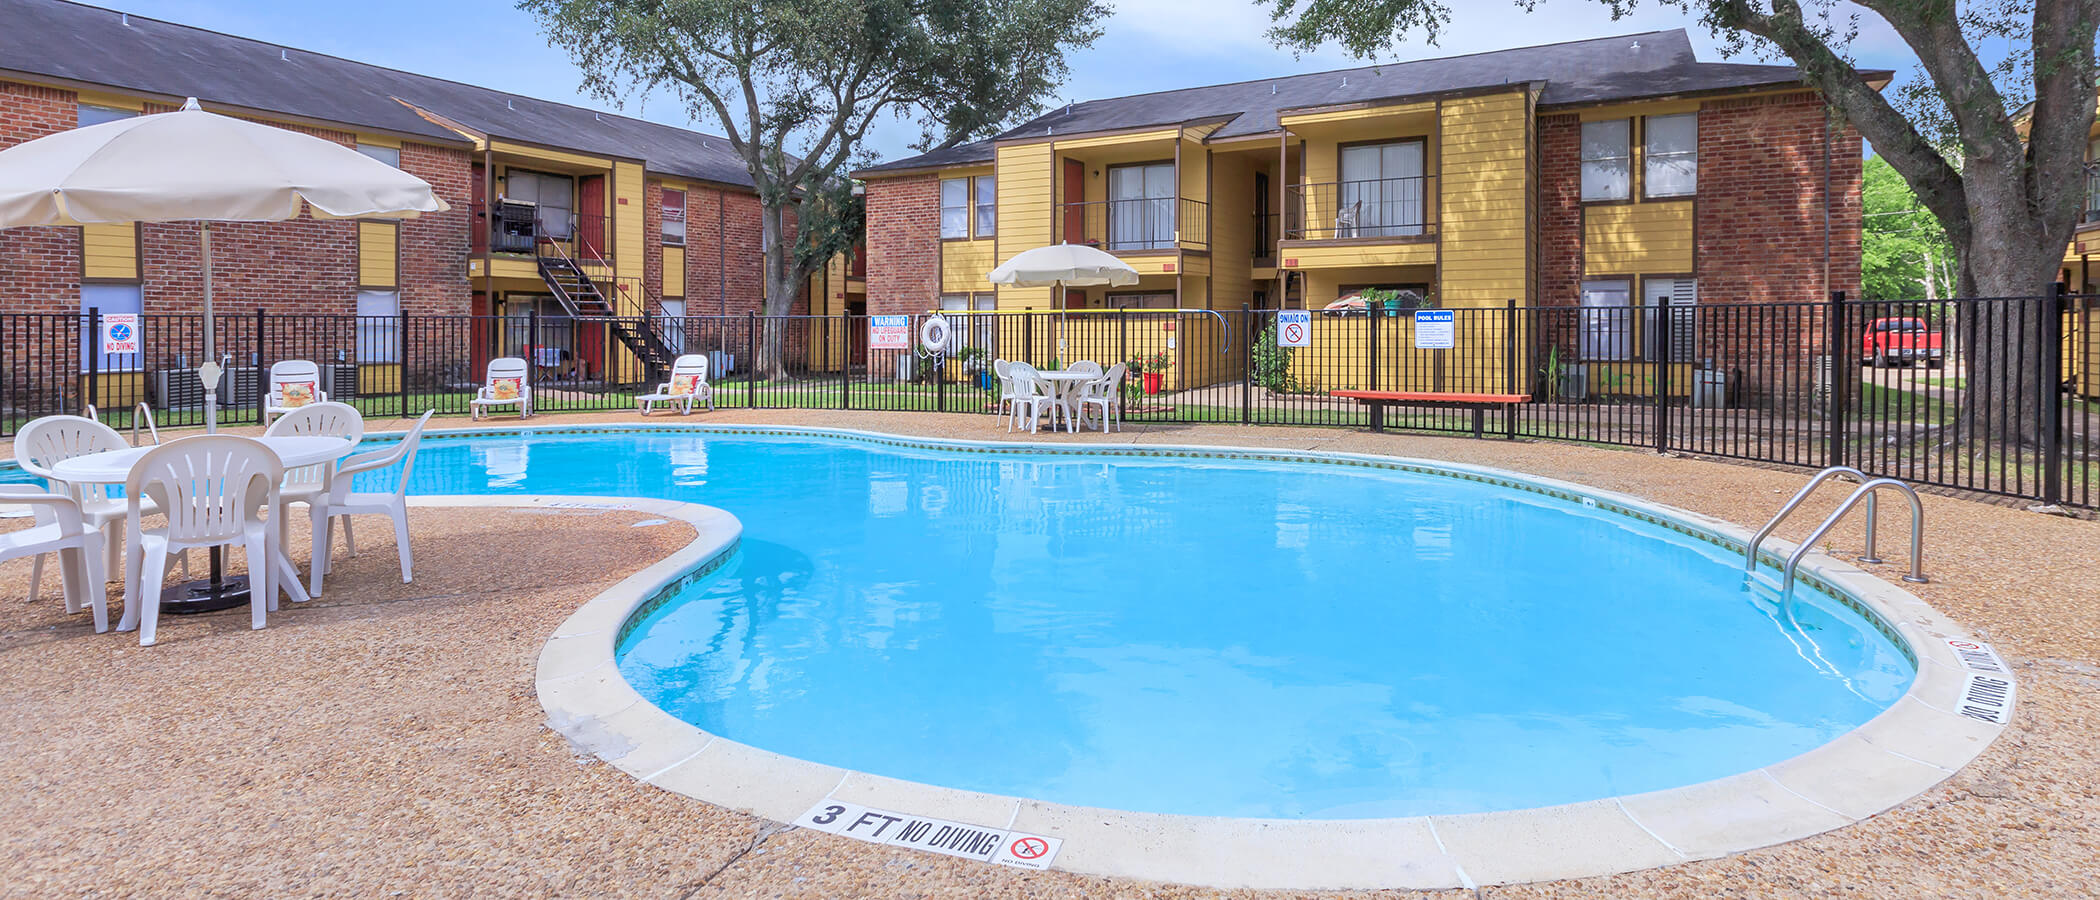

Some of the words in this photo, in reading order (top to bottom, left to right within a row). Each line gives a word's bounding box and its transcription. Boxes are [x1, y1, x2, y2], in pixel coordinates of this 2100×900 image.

[874, 317, 905, 326] WARNING
[106, 342, 114, 351] NO
[1966, 676, 2009, 707] DIVING
[812, 805, 846, 825] 3
[846, 811, 903, 837] FT
[895, 819, 933, 843] NO
[927, 825, 1000, 856] DIVING
